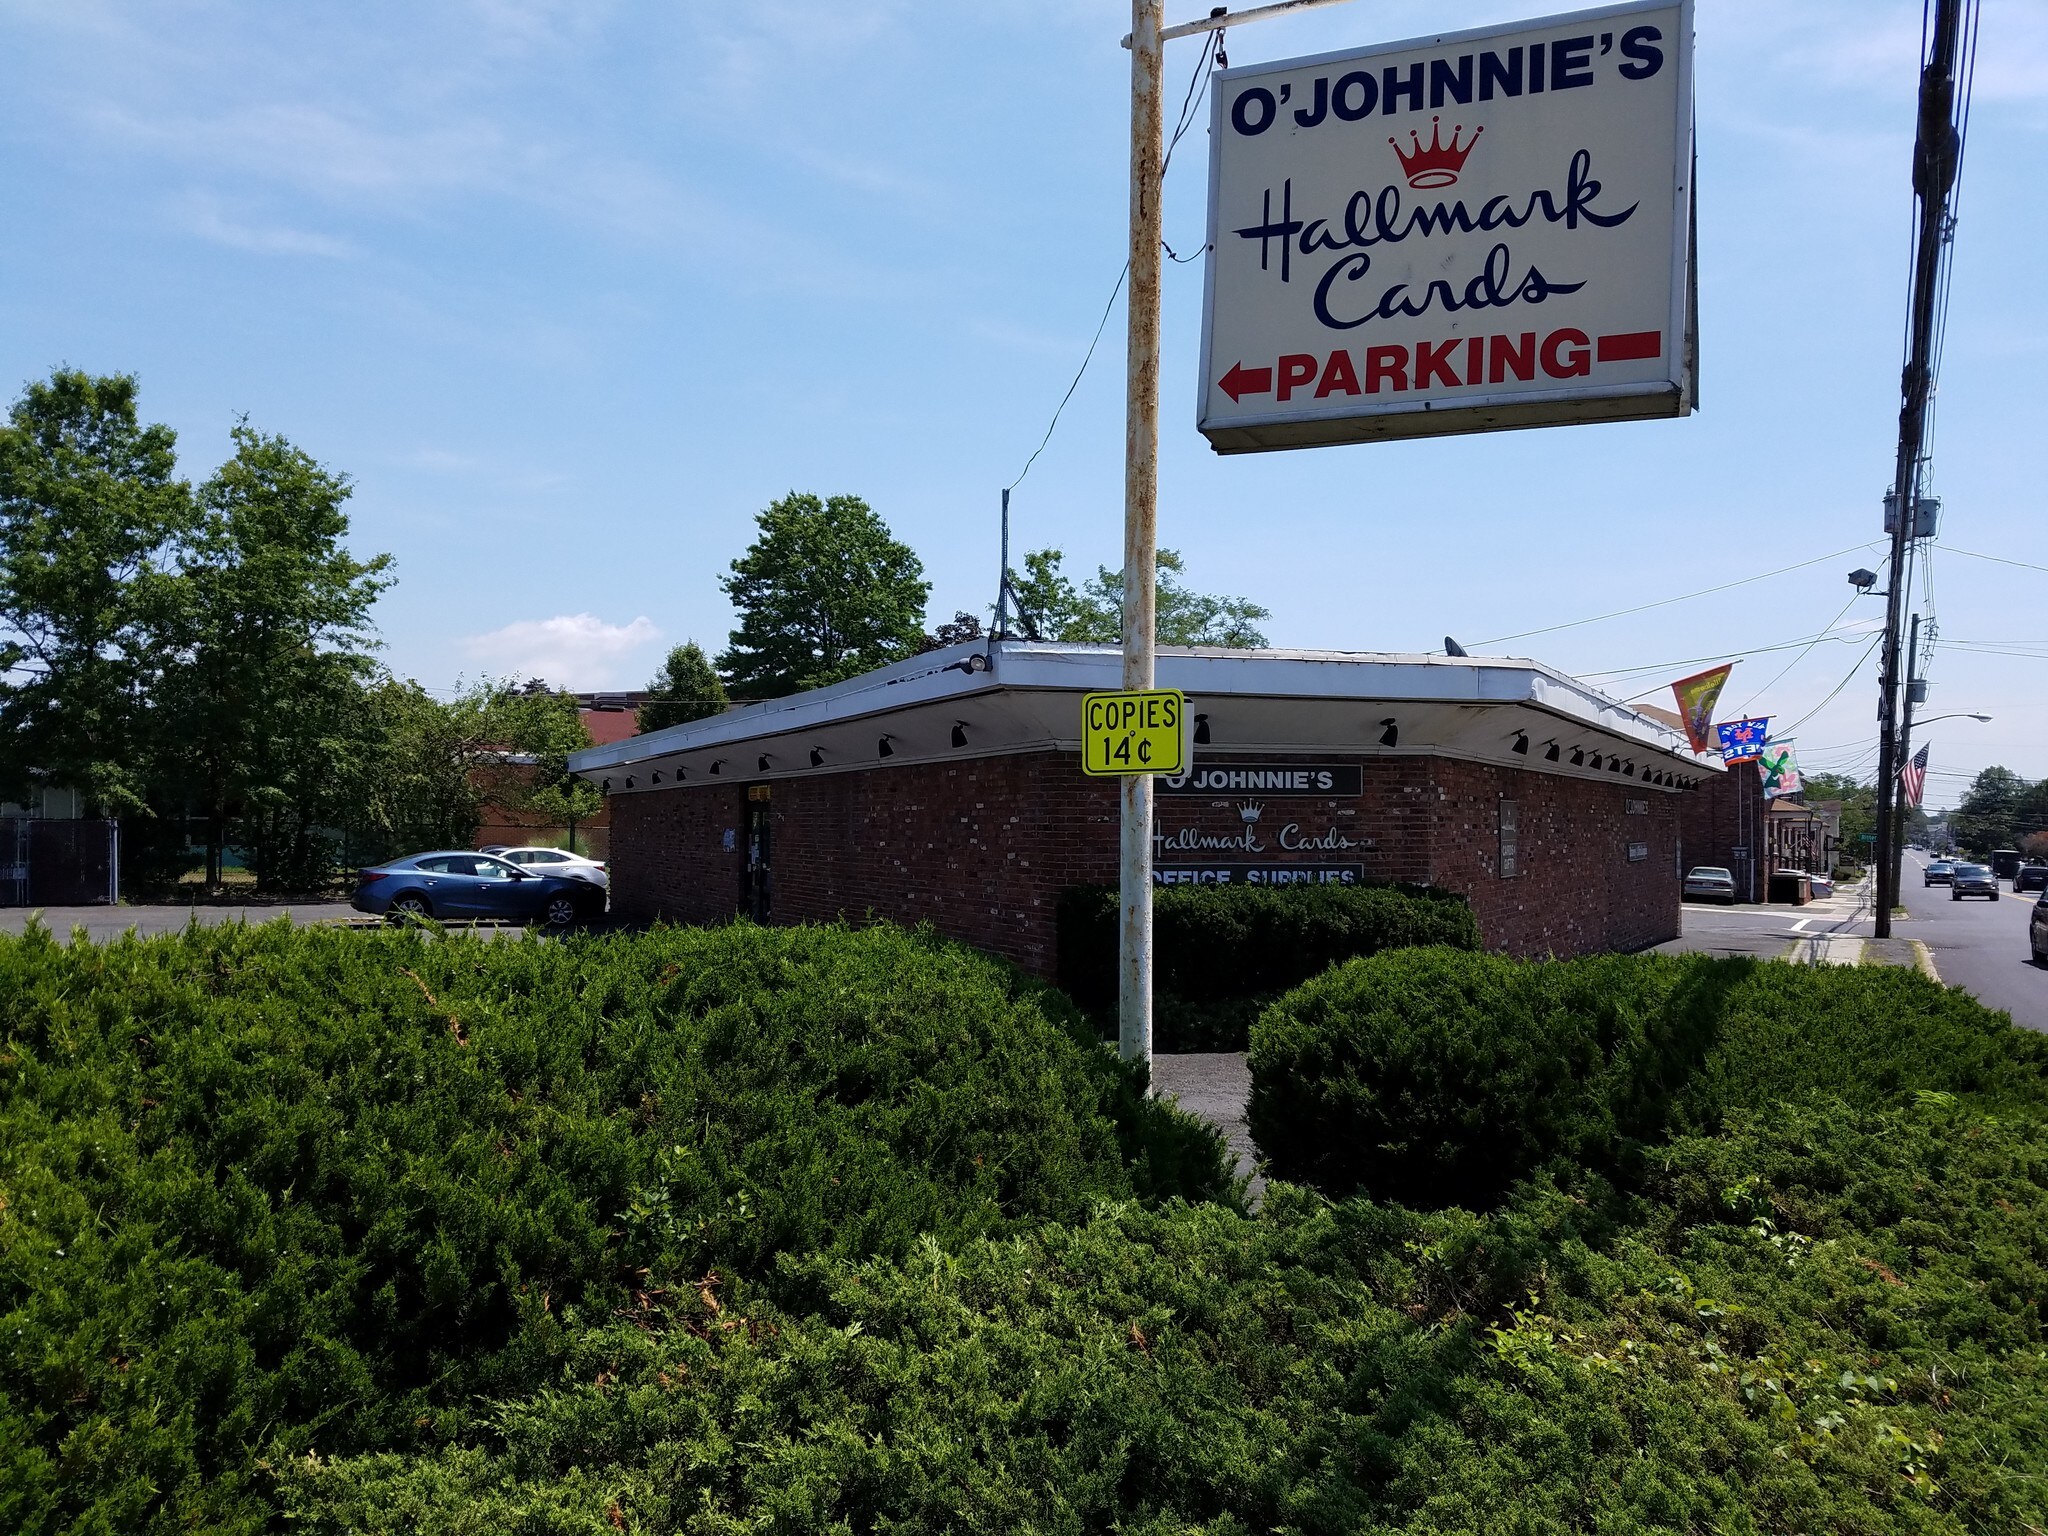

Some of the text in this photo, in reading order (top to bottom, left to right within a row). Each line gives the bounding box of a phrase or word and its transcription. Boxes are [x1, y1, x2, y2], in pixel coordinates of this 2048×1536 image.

[1231, 25, 1664, 136] O'JOHNNIE'S
[1231, 148, 1640, 283] Hallmark
[1313, 242, 1588, 330] Cards
[1276, 328, 1591, 402] PARKING
[1090, 699, 1176, 731] COPIES
[1166, 770, 1333, 789] OJOHNNIE'S
[1279, 823, 1358, 850] Cards
